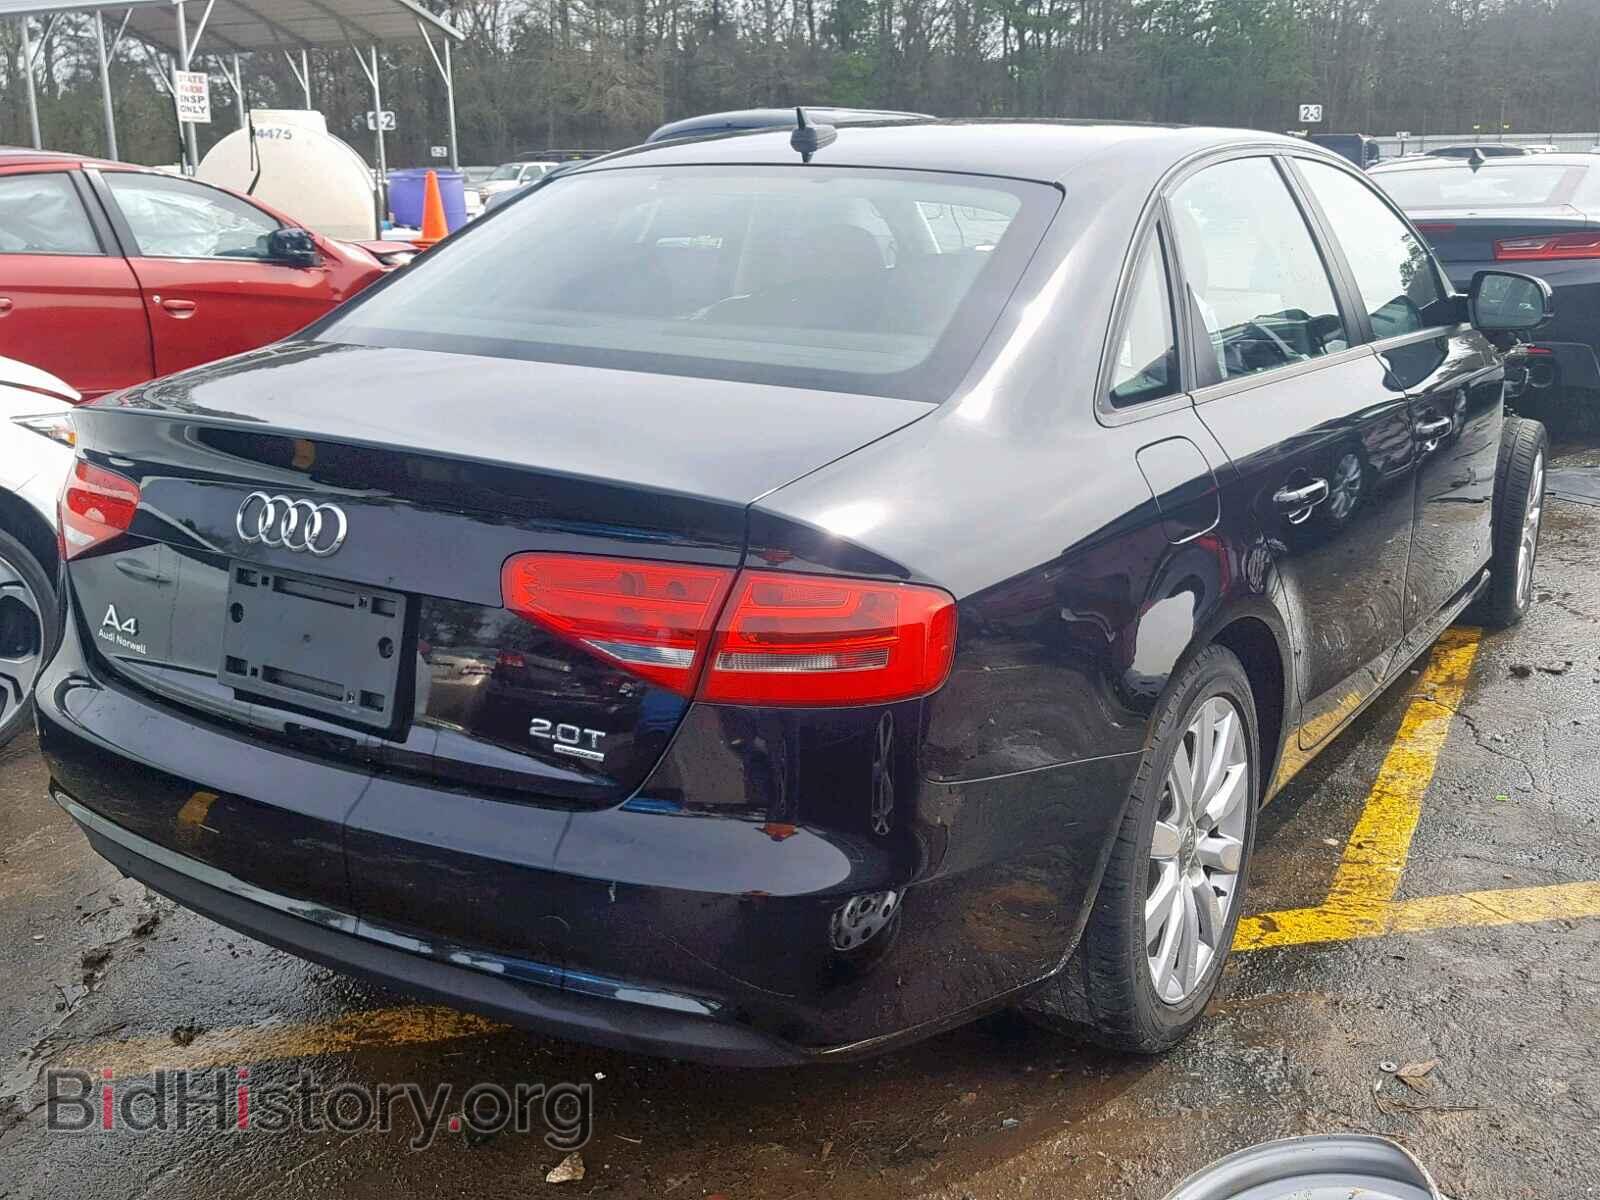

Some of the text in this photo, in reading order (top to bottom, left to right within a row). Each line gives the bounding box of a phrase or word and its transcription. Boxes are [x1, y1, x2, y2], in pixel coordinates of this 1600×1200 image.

[180, 95, 206, 104] INSP
[180, 104, 207, 114] ONLY
[102, 604, 136, 635] A4
[98, 629, 146, 654] Audi Norwell
[529, 717, 606, 749] 2.0T
